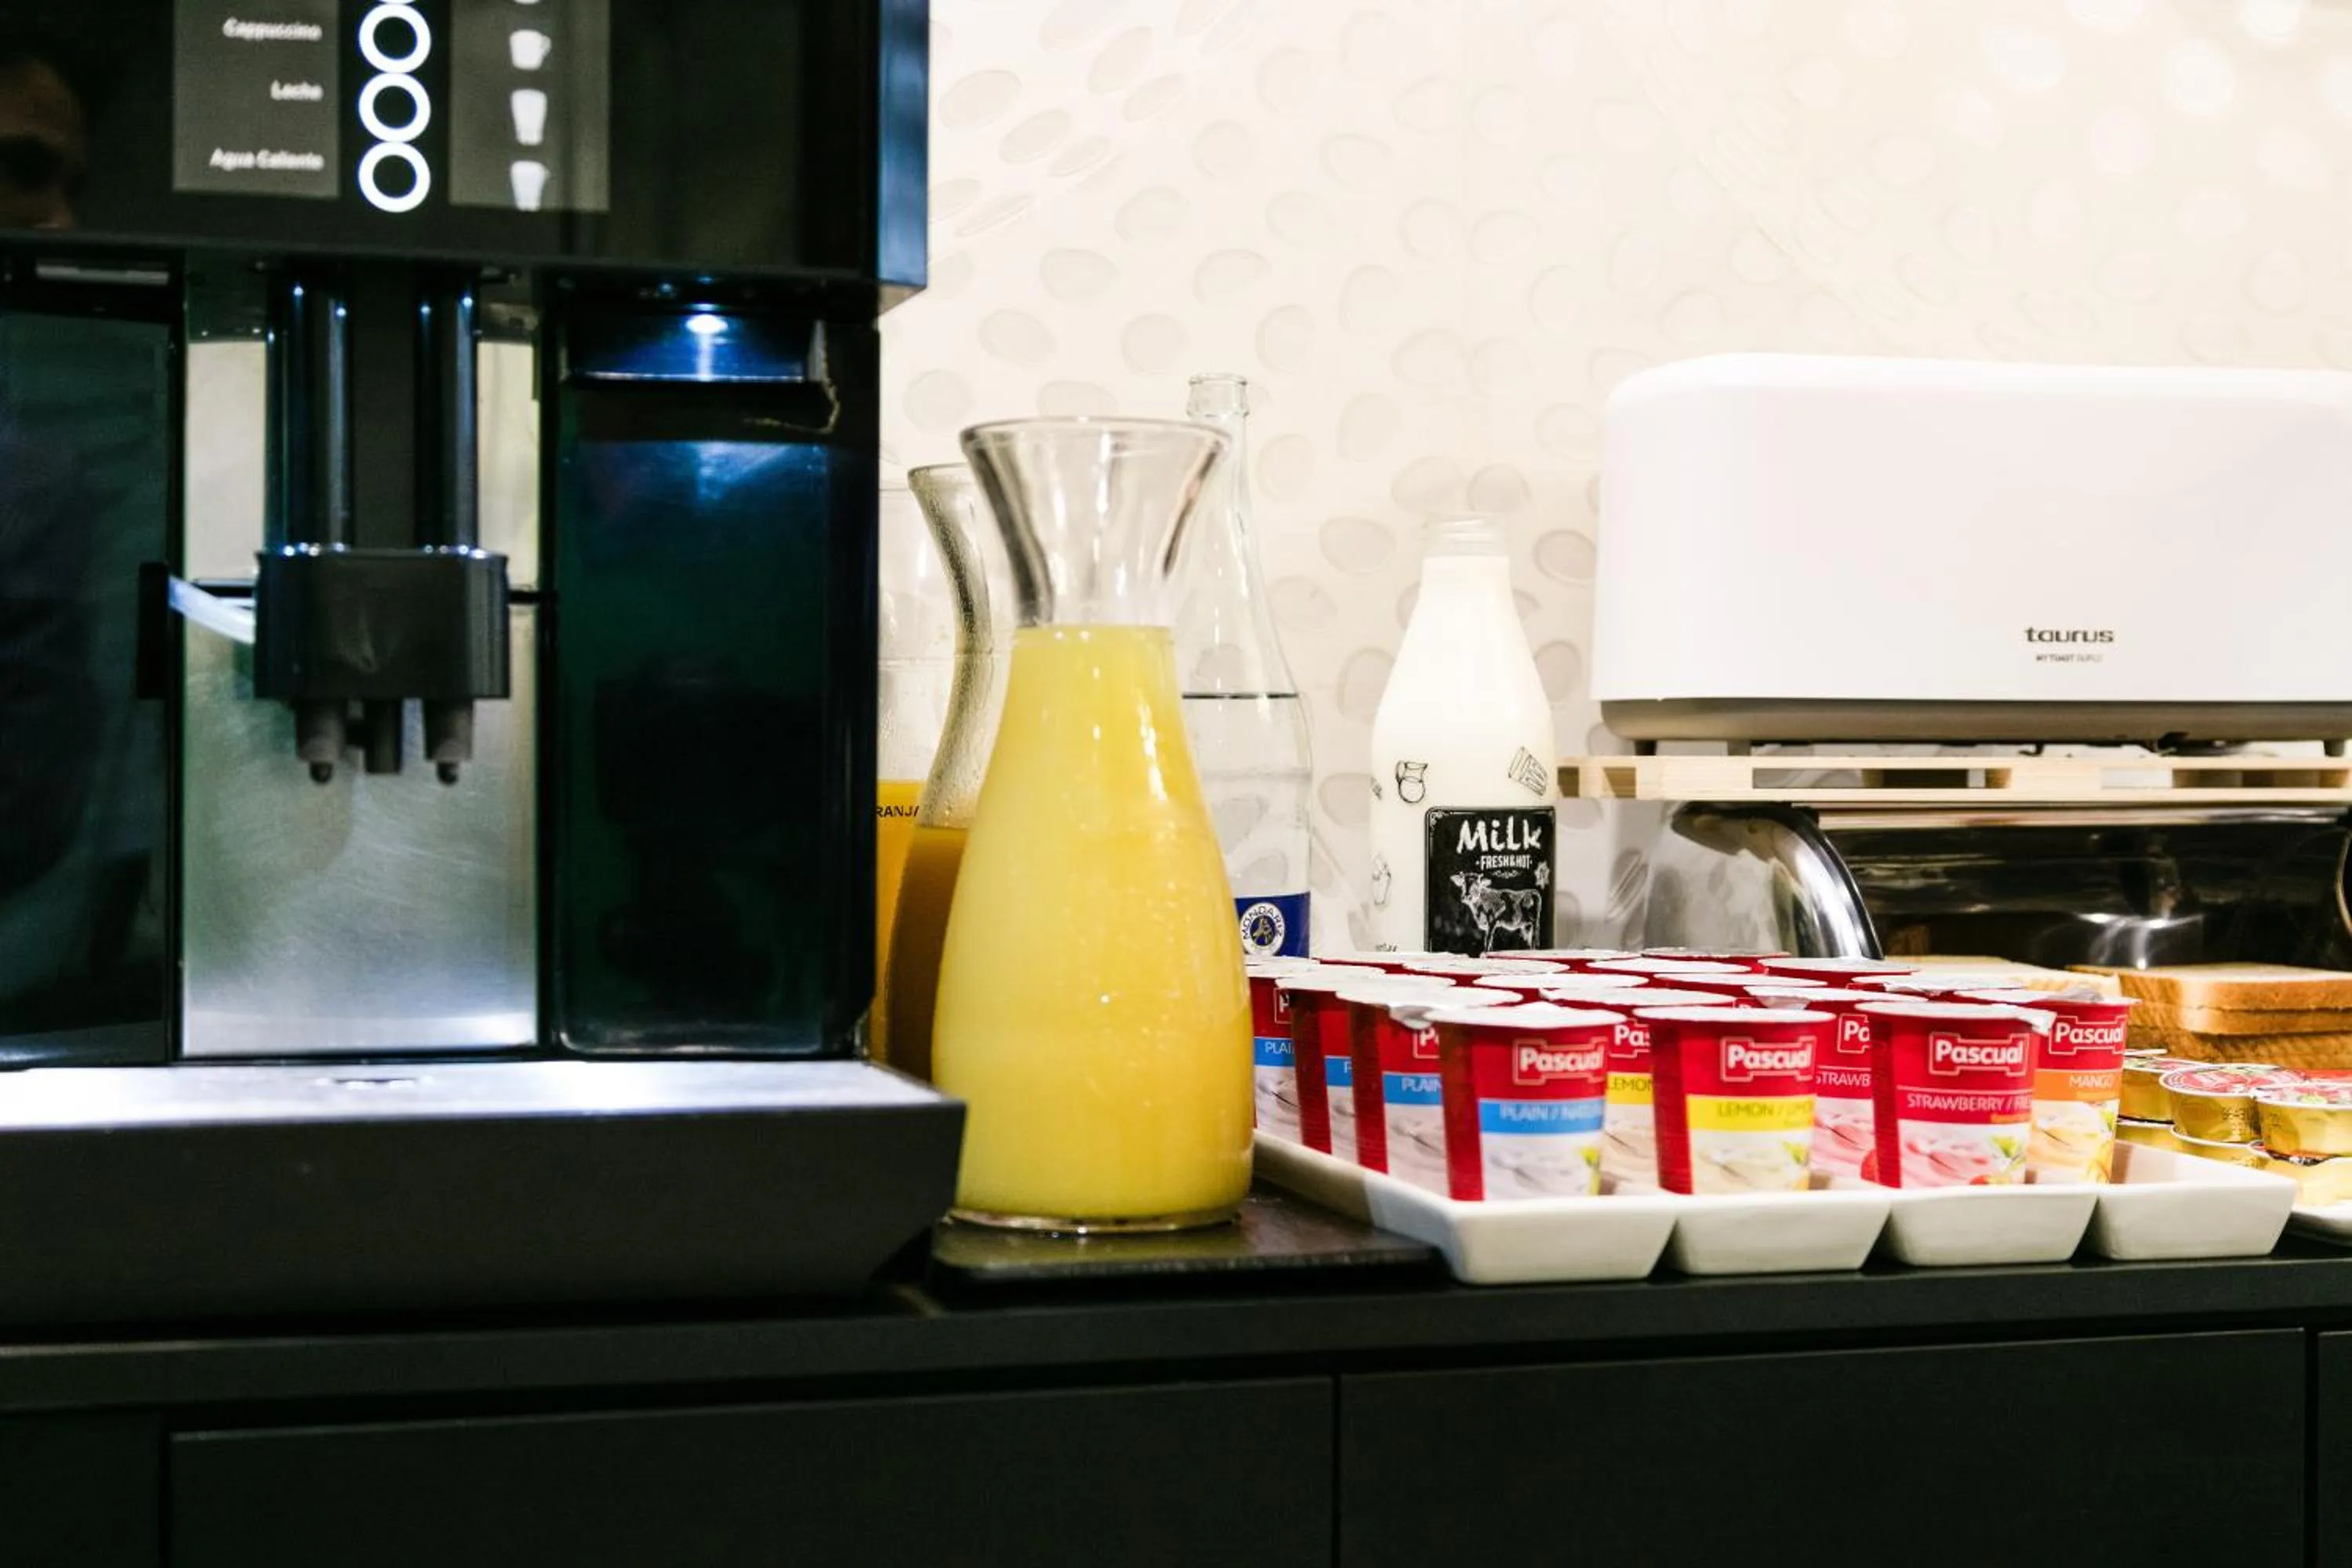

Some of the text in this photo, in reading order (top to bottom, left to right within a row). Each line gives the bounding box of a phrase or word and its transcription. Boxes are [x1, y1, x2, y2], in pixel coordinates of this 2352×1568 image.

[209, 147, 255, 172] Agua
[2025, 626, 2114, 643] taurus
[2054, 1019, 2125, 1045] Pascual
[1265, 1040, 1294, 1054] PLAI
[1519, 1046, 1604, 1073] Pascual
[1726, 1043, 1813, 1069] Pascual
[1935, 1040, 2024, 1065] Pascual
[1718, 1102, 1774, 1119] LEMON
[1906, 1093, 2005, 1112] STRAWBERRY
